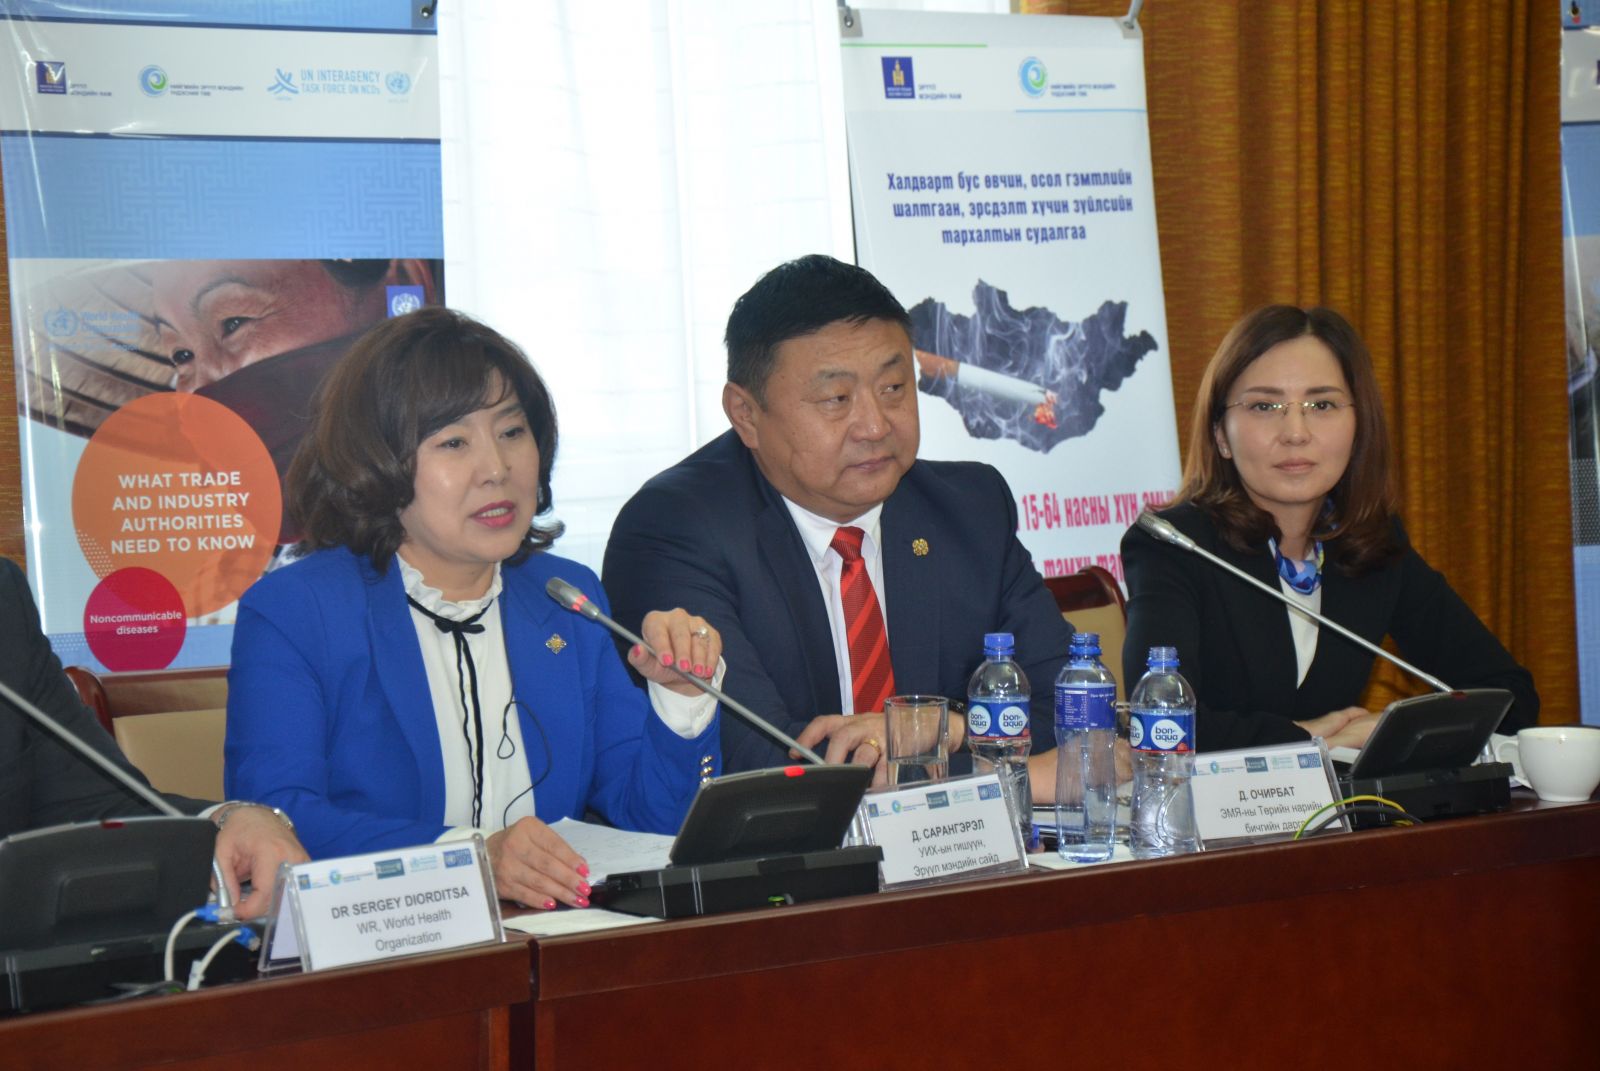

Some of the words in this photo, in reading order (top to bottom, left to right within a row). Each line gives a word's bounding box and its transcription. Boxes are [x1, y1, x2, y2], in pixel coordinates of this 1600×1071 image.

[300, 69, 313, 81] UN
[317, 70, 380, 82] INTERAGENCY
[301, 83, 320, 92] TASK
[322, 84, 346, 93] FORCE
[349, 84, 358, 94] ON
[887, 173, 953, 192] Халдварт
[958, 171, 980, 192] бус
[984, 174, 1027, 190] өвчин,
[1031, 172, 1062, 187] осол
[1066, 168, 1133, 186] гэмтлийн
[893, 202, 965, 217] шалтгаан,
[969, 201, 1027, 219] эрсдэлт
[1032, 199, 1069, 216] хүчин
[1073, 195, 1133, 214] зүйлсийн
[942, 228, 1021, 246] тархалтын
[1026, 225, 1086, 245] судалгаа
[118, 474, 173, 489] WHAT
[179, 472, 241, 487] TRADE
[112, 496, 152, 511] AND
[158, 492, 250, 509] INDUSTRY
[1022, 493, 1061, 530] 15-64
[1064, 495, 1111, 527] насны
[1113, 492, 1138, 527] хүн
[121, 514, 244, 532] AUTHORITIES
[111, 540, 160, 554] NEED
[167, 538, 191, 551] TO
[197, 535, 255, 550] KNOW
[90, 611, 182, 624] Noncommunicable
[116, 624, 158, 635] diseases
[1003, 712, 1022, 721] bon-
[1155, 726, 1175, 734] bon-
[1239, 790, 1248, 802] Д.
[1250, 786, 1295, 800] ОЧИРБАТ
[1220, 807, 1257, 819] ЭМЯ-ны
[1259, 804, 1291, 817] Төрийн
[1292, 801, 1323, 815] нарийн
[911, 829, 922, 843] Д.
[923, 819, 985, 840] САРАНГЭРЭЛ
[1245, 822, 1280, 833] бичгийн
[918, 844, 952, 858] УИХ-ын
[953, 838, 986, 853] гишүүн,
[913, 864, 940, 877] Эрүүл
[942, 857, 977, 872] мэндийн
[978, 853, 1000, 866] сайд
[331, 904, 349, 919] DR
[352, 899, 401, 916] SERGEY
[404, 886, 469, 908] DIORDITSA
[356, 919, 382, 935] WR,
[384, 913, 416, 930] World
[417, 908, 452, 925] Health
[375, 930, 442, 953] Organization
